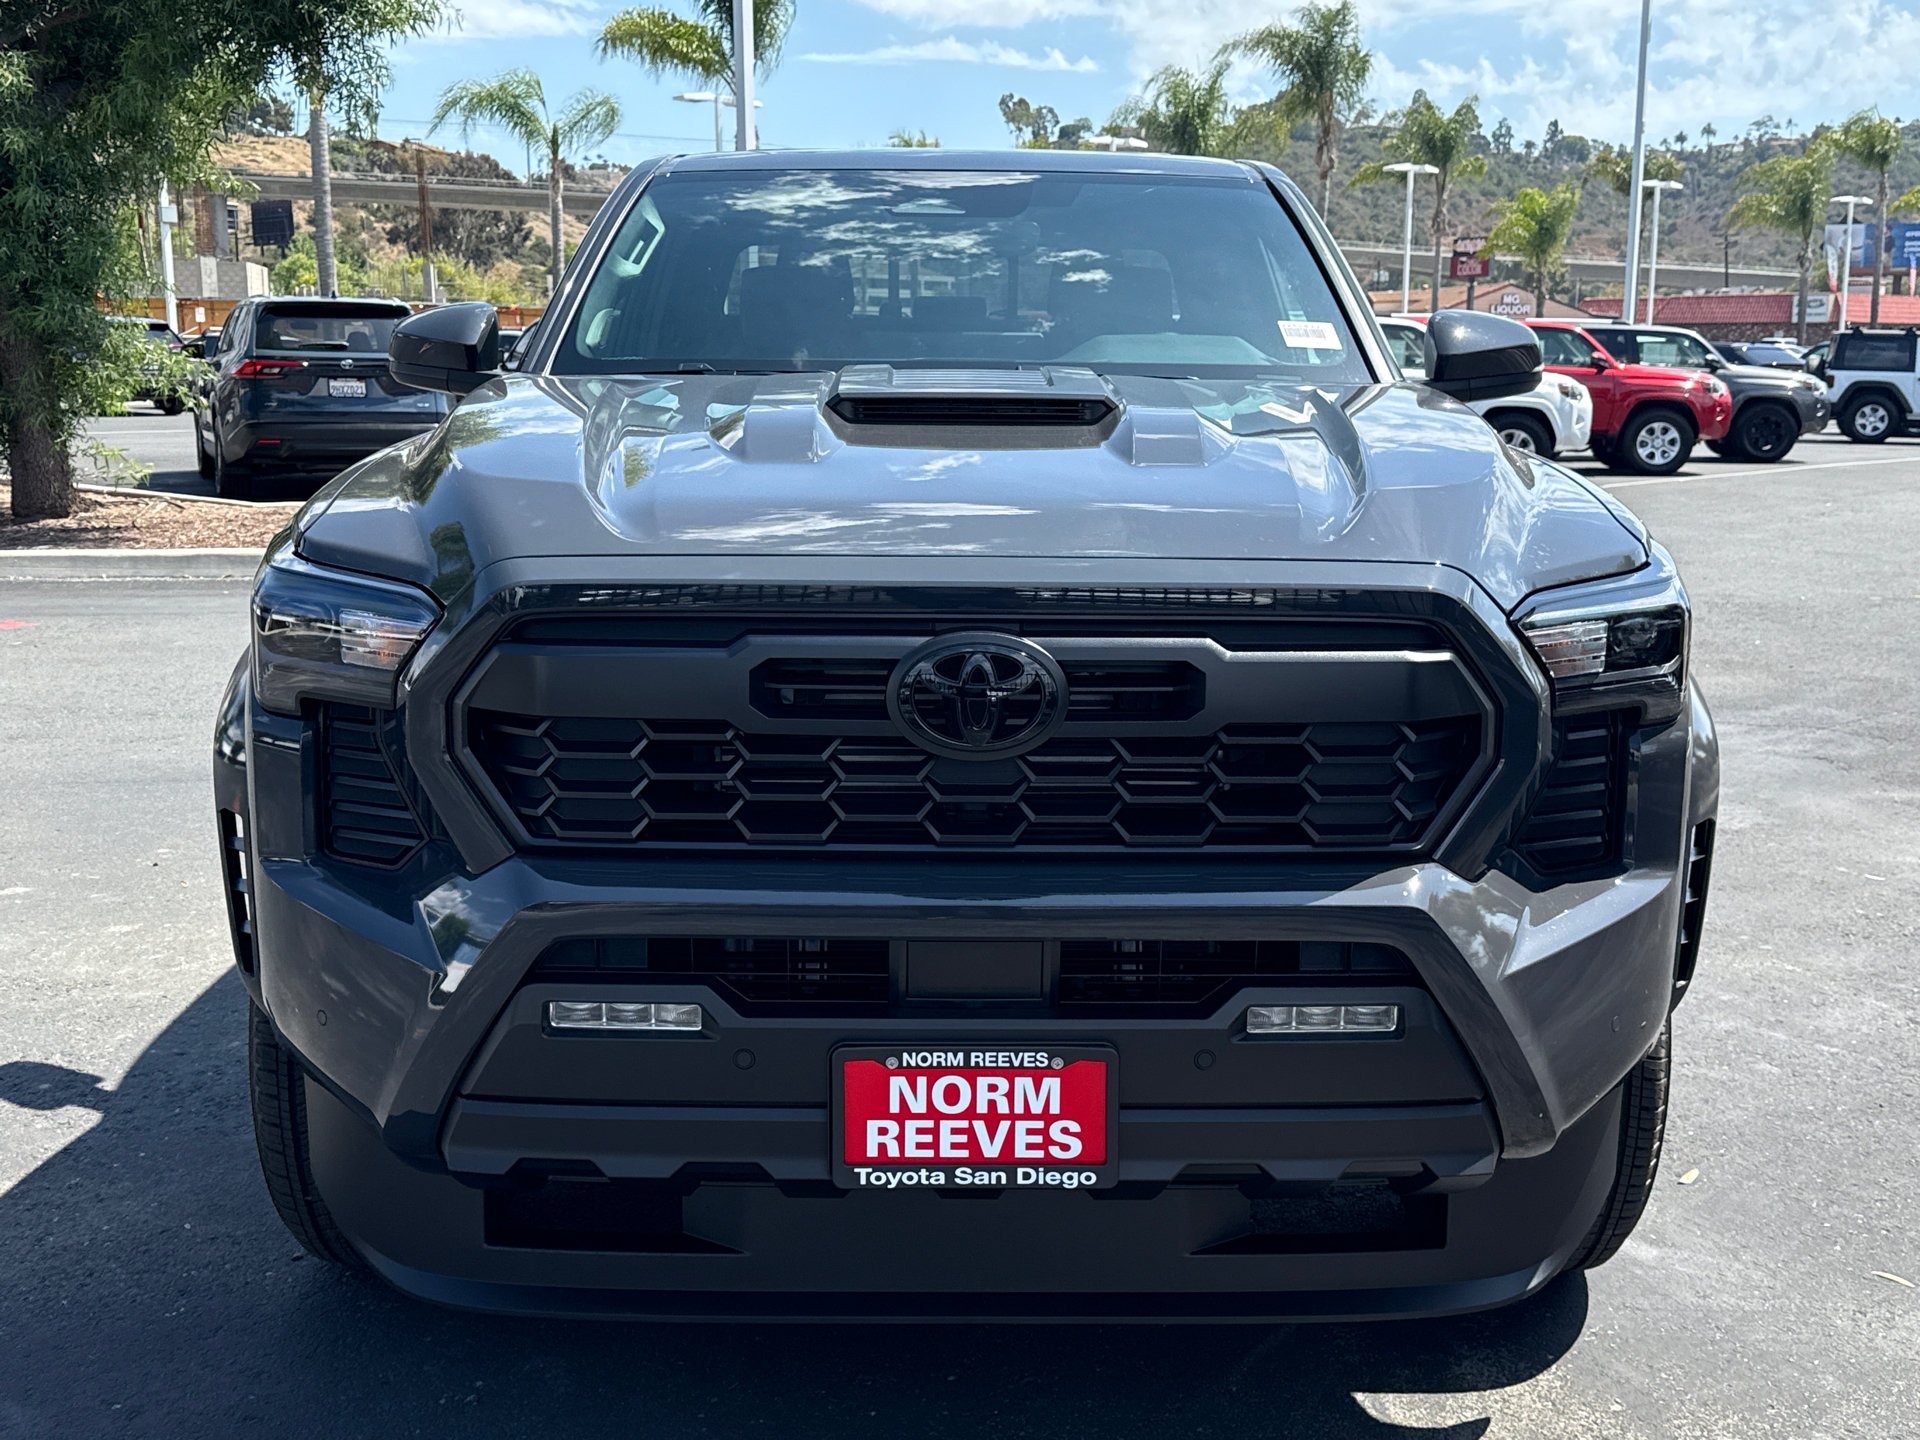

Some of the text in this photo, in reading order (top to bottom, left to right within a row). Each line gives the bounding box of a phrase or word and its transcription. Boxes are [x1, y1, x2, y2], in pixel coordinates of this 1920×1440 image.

[1490, 304, 1531, 314] LIQUOR
[902, 1052, 1049, 1067] NORM REEVES
[889, 1075, 1061, 1115] NORM
[866, 1119, 1083, 1159] REEVES
[854, 1167, 1097, 1189] Toyota San Diego
